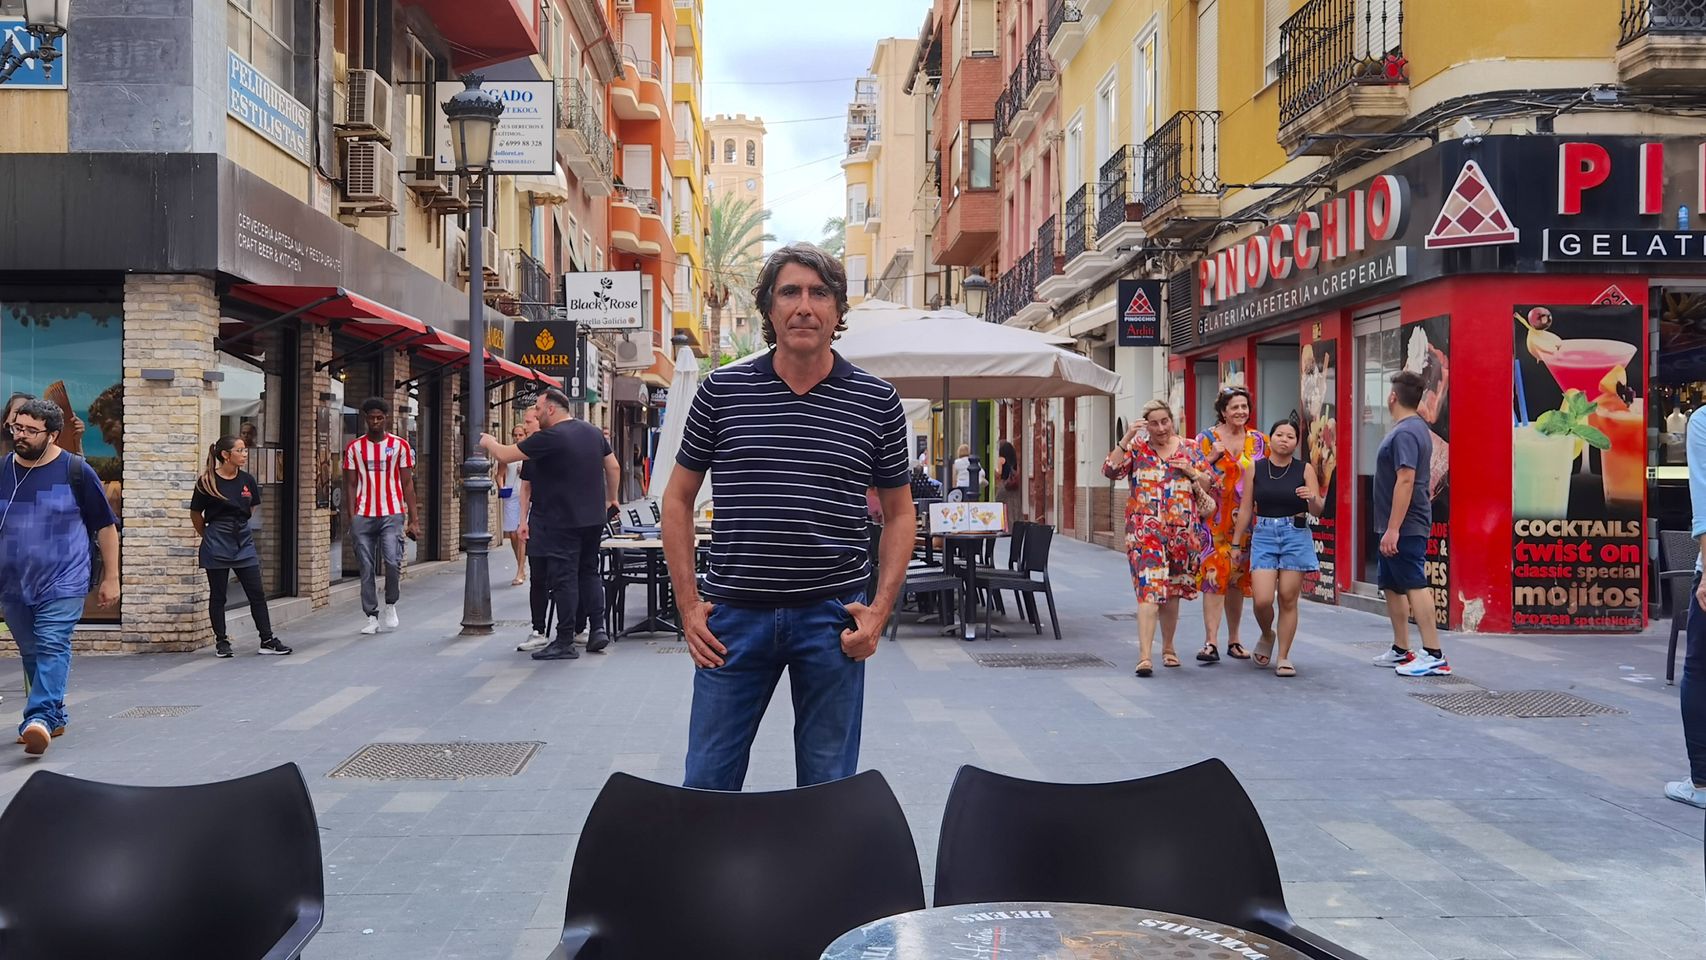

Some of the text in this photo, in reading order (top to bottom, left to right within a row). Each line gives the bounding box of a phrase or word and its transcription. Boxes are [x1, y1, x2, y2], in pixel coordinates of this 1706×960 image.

[230, 55, 305, 130] PELUQUEROS
[230, 87, 304, 156] ESTILISTAS
[1558, 142, 1706, 215] PI
[274, 231, 305, 256] ARTESANAL
[1201, 174, 1401, 306] PINOCCHIO
[1559, 233, 1706, 256] GELAT
[238, 232, 258, 253] CRAFT
[259, 241, 274, 260] BEER
[280, 252, 302, 272] KITCHEN
[570, 299, 638, 310] Black Rose
[1198, 255, 1394, 334] GELATERIA CAFETERIA CREPERIA
[1127, 323, 1156, 336] Arditi
[520, 353, 569, 366] AMBER
[1514, 519, 1640, 537] COCKTAILS
[1440, 540, 1447, 556] &
[1515, 539, 1639, 562] twist on
[1514, 564, 1640, 582] classic special
[1514, 581, 1640, 614] mojitos
[1514, 611, 1570, 625] frozen
[952, 910, 1054, 924] BEERS
